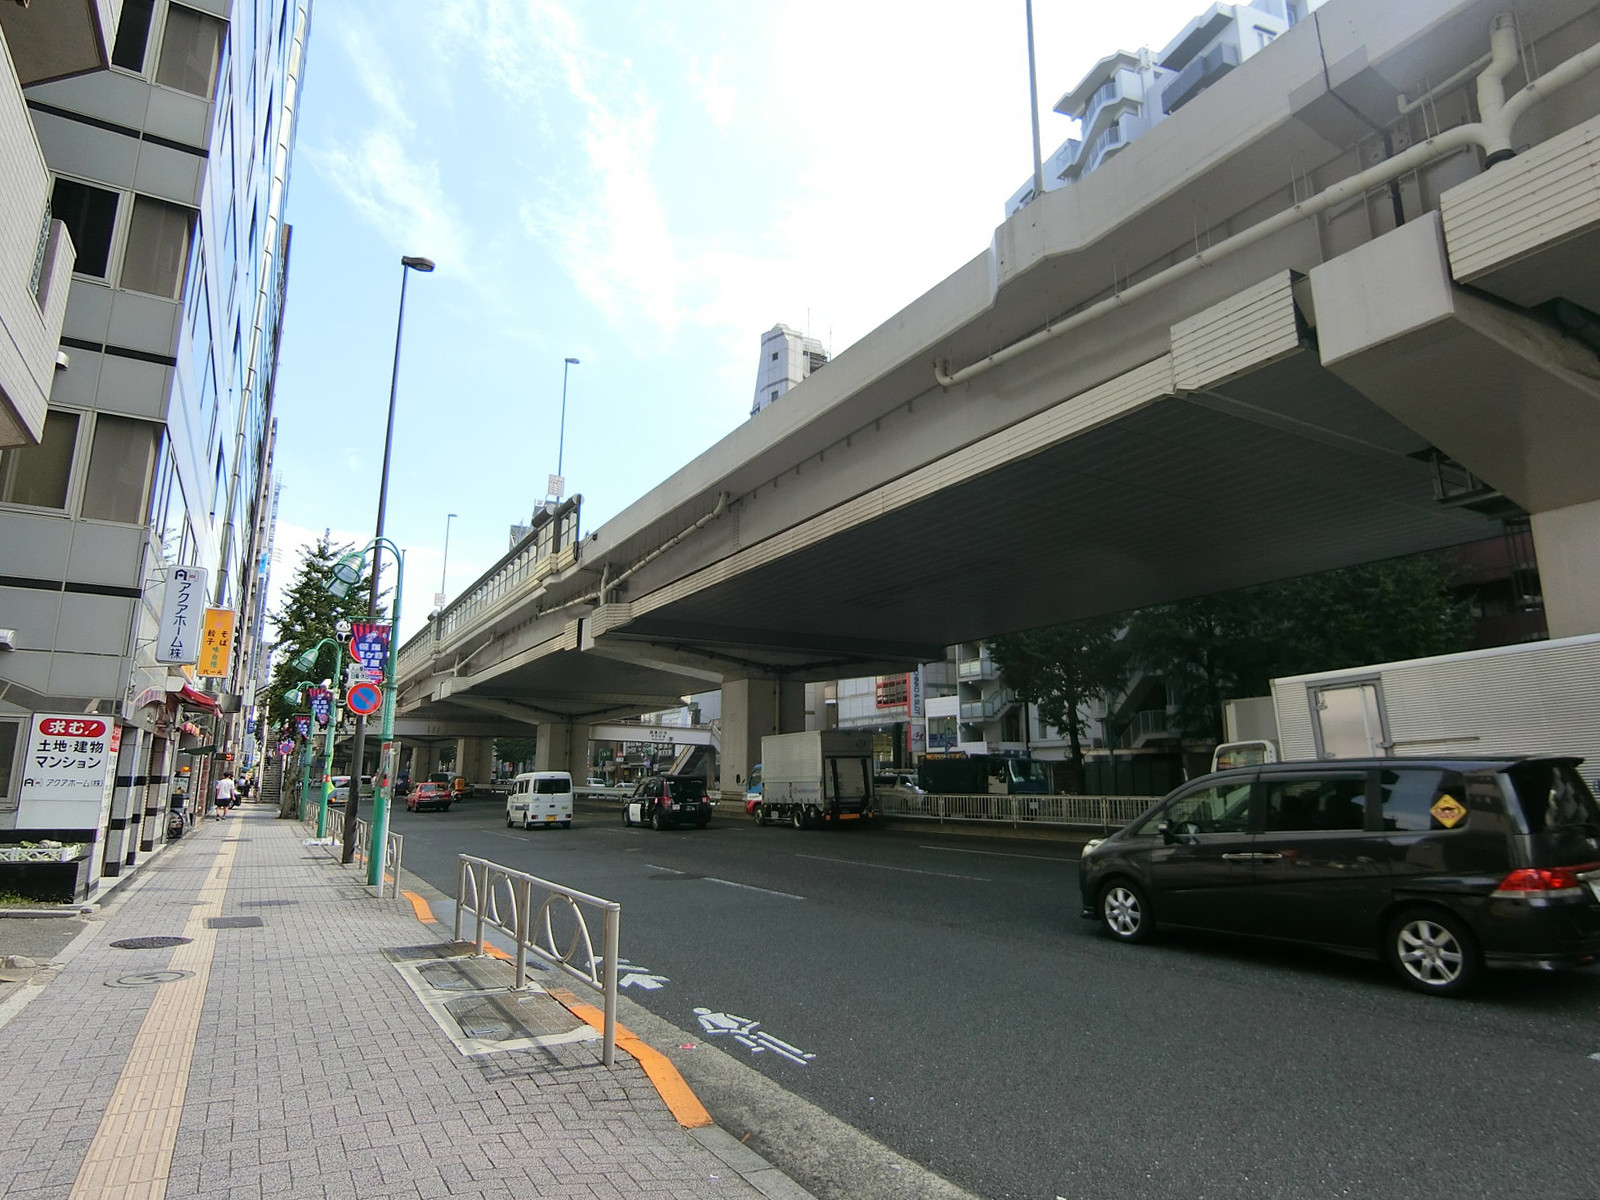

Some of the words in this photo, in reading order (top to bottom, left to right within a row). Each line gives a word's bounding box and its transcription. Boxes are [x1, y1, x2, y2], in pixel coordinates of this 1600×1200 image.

[206, 629, 216, 646] 餃子
[219, 630, 228, 646] そば
[37, 739, 104, 754] 土地・建物
[36, 756, 102, 769] マンション
